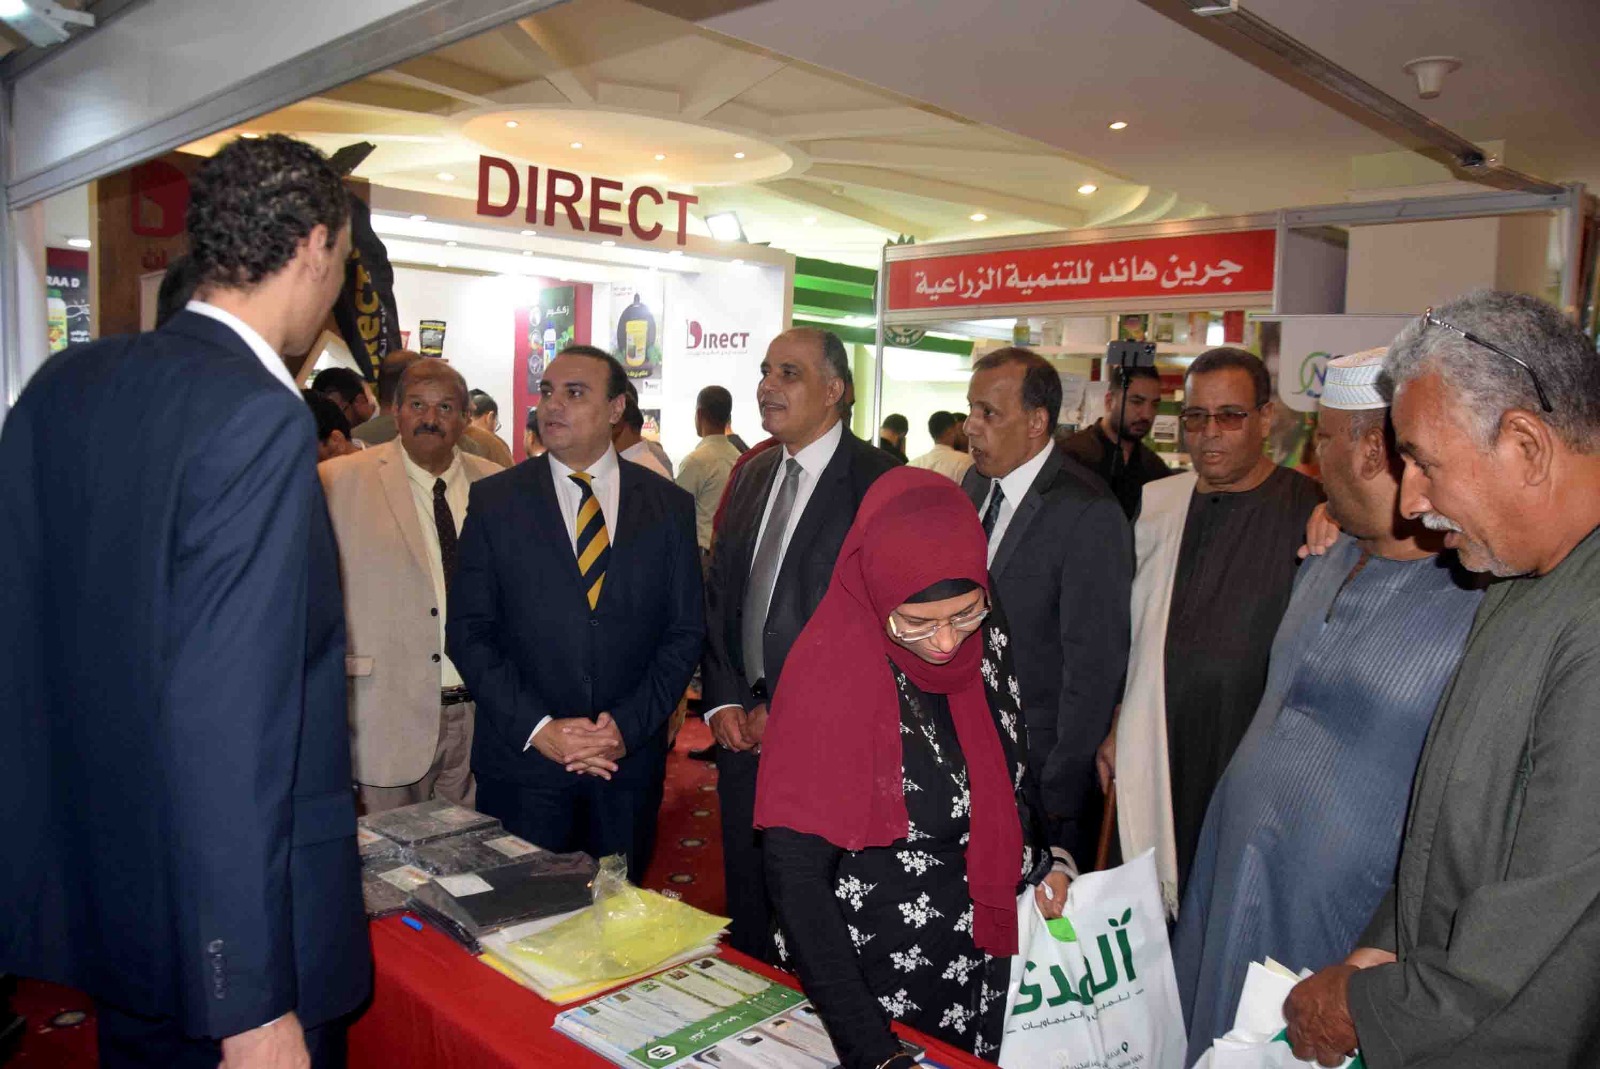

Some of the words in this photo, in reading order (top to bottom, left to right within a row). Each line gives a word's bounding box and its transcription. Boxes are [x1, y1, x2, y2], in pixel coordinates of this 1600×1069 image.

[476, 155, 698, 245] DIRECT
[70, 277, 81, 288] D
[915, 266, 1002, 300] الزراعية
[1005, 259, 1094, 295] للتنمية
[1098, 255, 1158, 283] هاند
[1160, 254, 1244, 288] جرين
